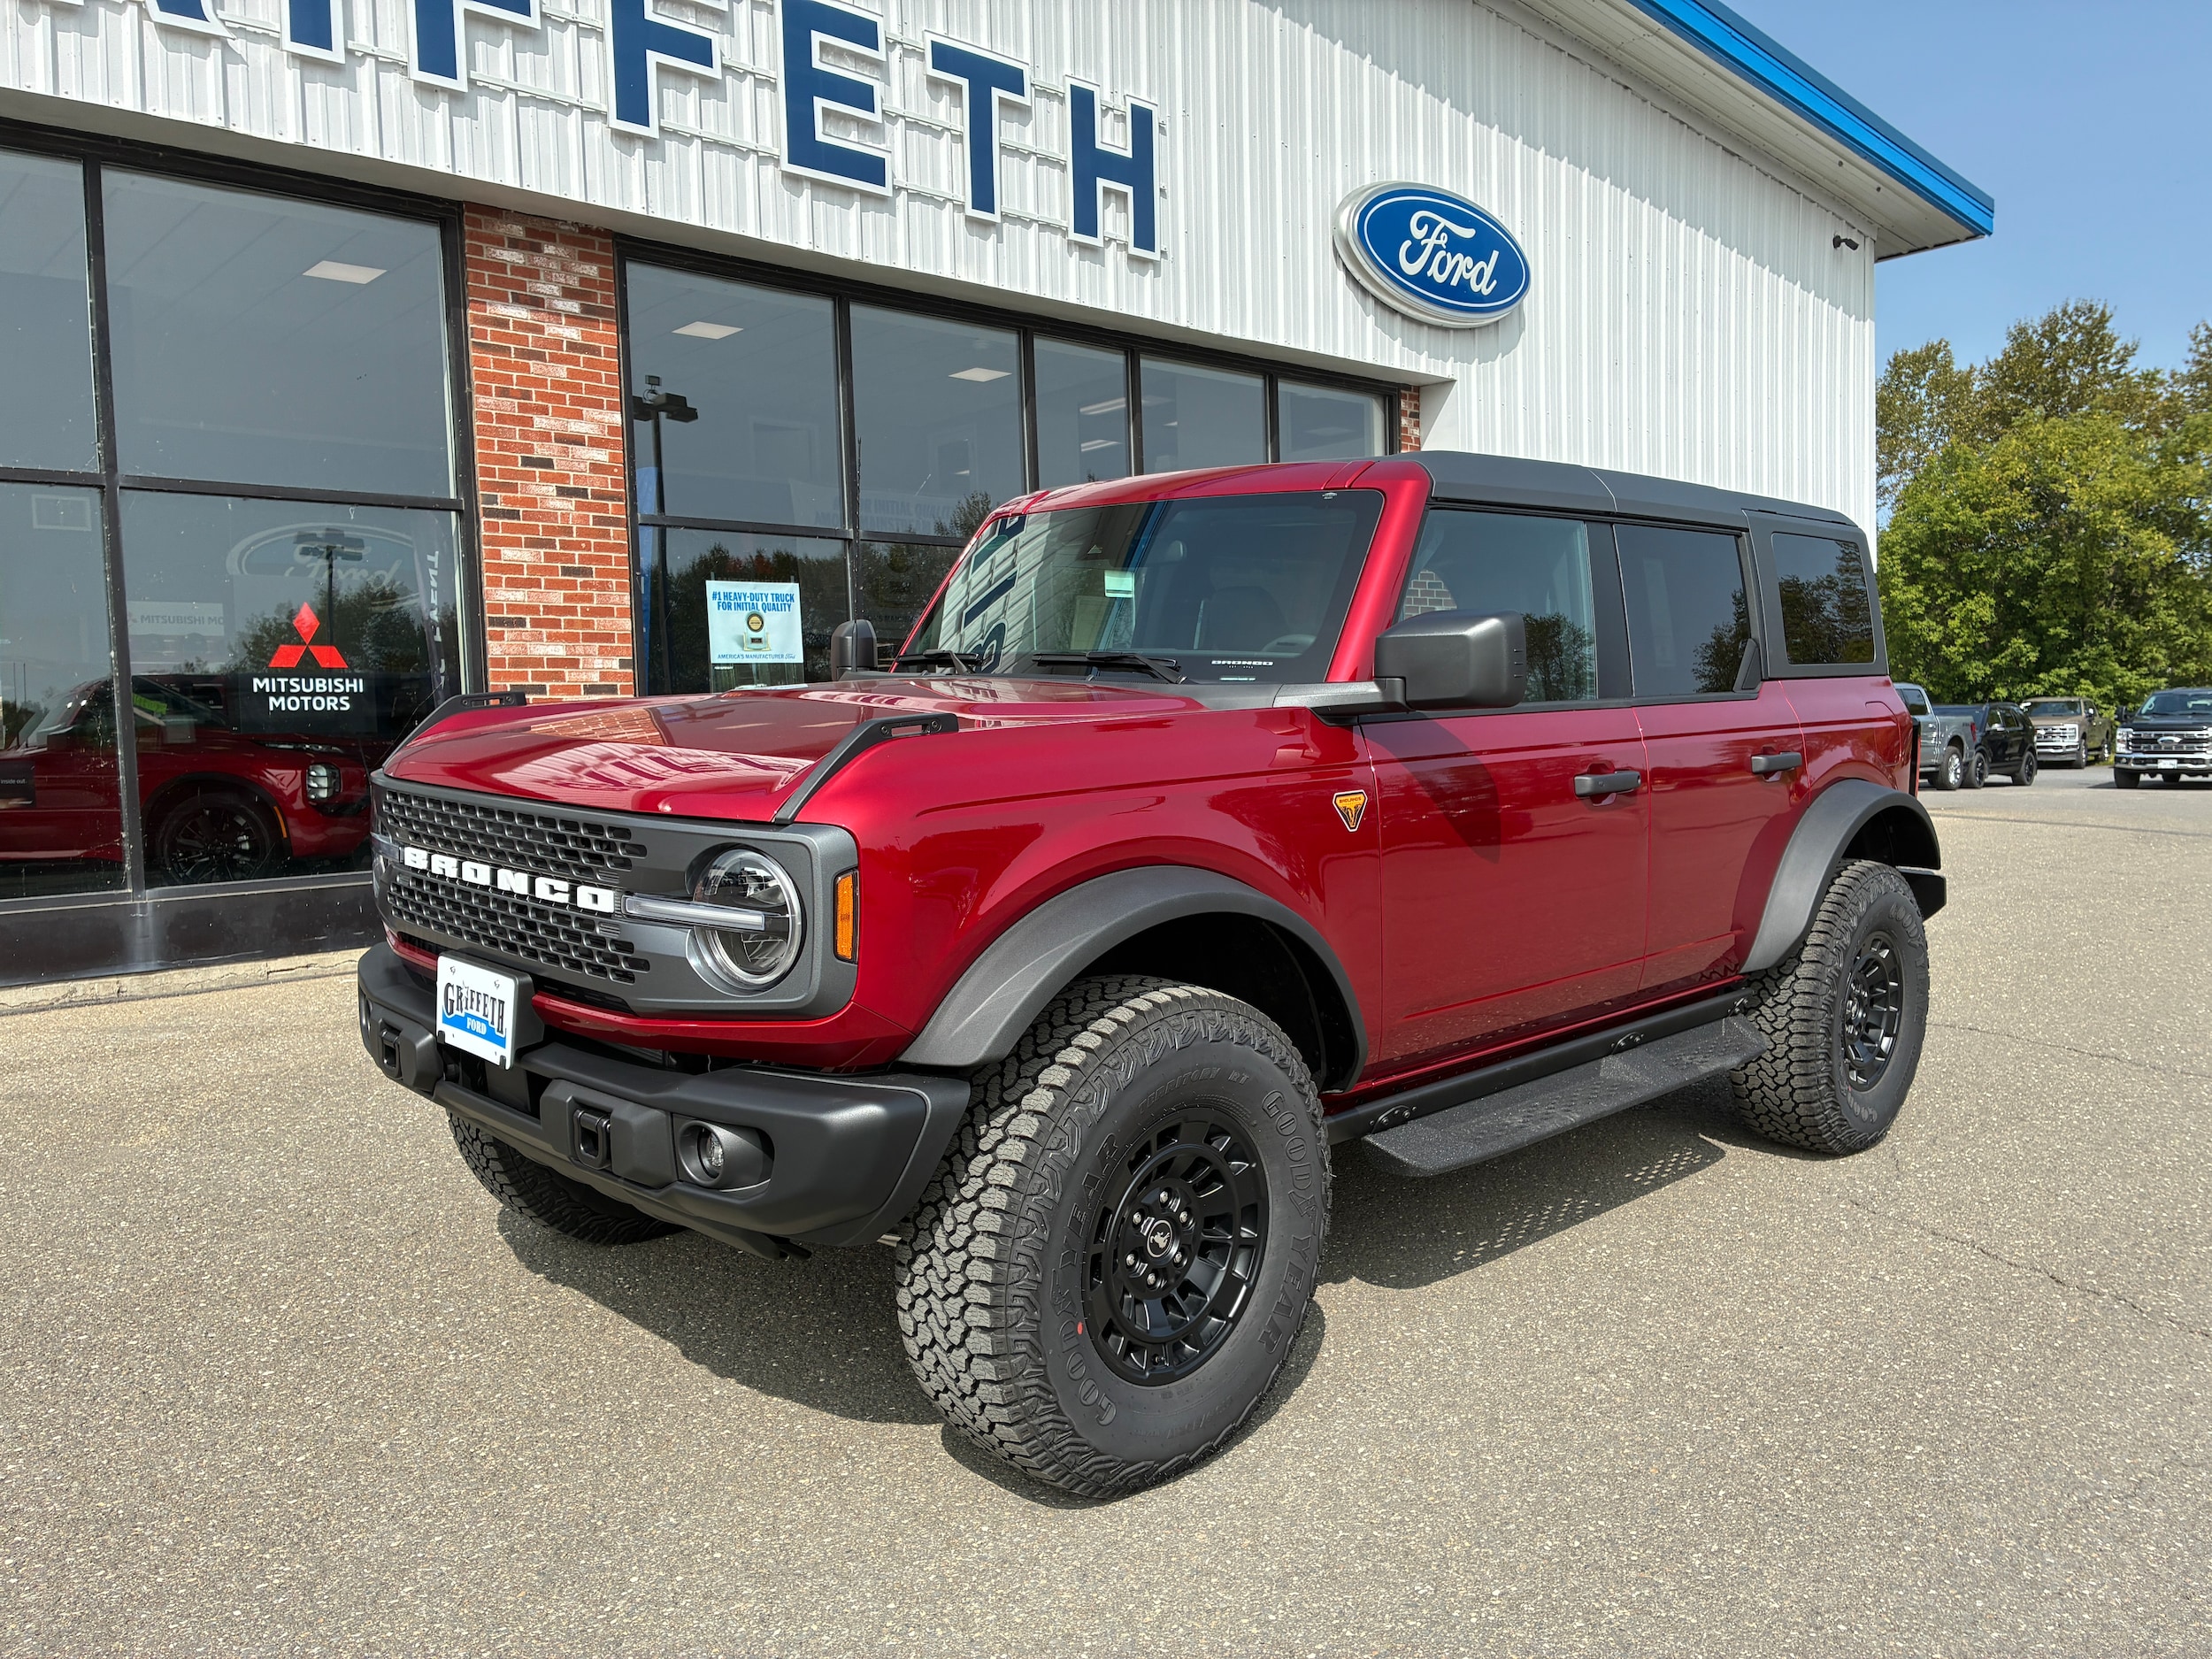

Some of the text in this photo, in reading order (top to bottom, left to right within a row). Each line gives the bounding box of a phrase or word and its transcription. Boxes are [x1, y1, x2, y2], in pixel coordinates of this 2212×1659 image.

[1399, 210, 1500, 296] Ford
[711, 591, 795, 603] #1 HEAVY-DUTY TRUCK
[717, 602, 792, 613] FOR INITIAL QUALITY
[140, 614, 205, 625] MITSUBISHI
[252, 677, 364, 694] MITSUBISHI
[268, 695, 351, 711] MOTORS
[403, 846, 616, 914] BRONCO
[466, 1018, 488, 1035] FORD
